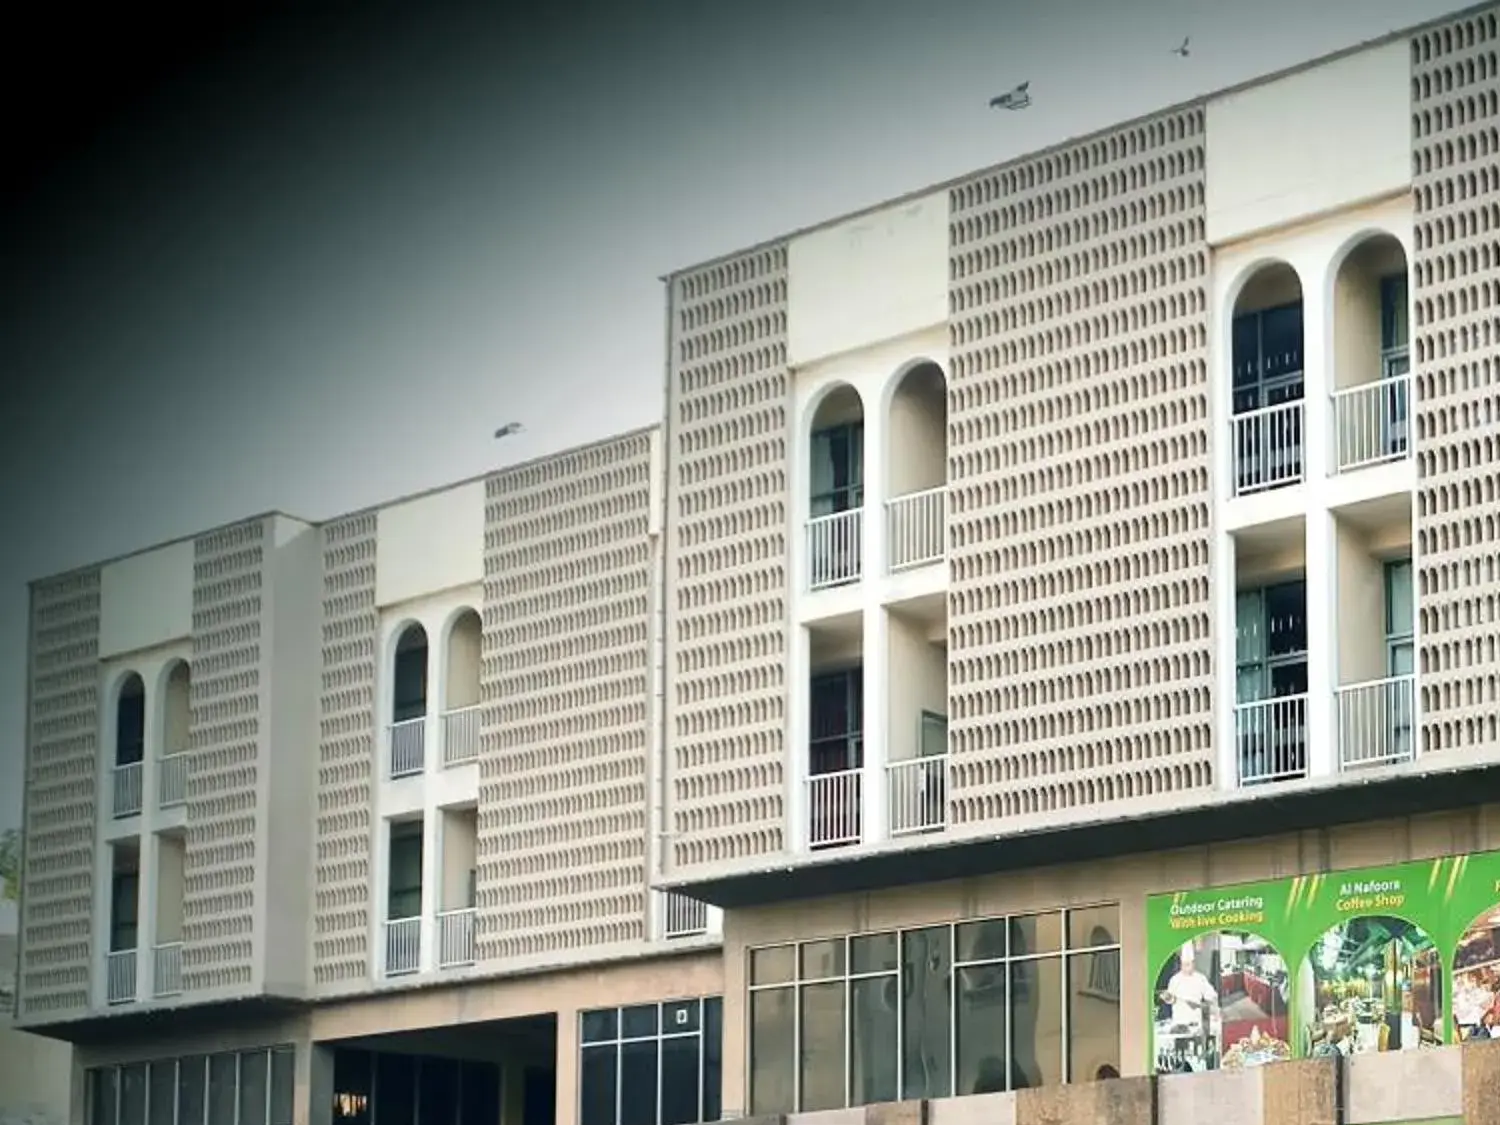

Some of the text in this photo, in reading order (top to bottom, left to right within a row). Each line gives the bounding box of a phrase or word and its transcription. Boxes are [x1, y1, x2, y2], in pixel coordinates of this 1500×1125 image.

[1353, 880, 1401, 894] Nafoora
[1170, 895, 1263, 916] Outdoor Catering
[1336, 892, 1405, 911] Coffee Shop
[1218, 911, 1263, 926] Cooking
